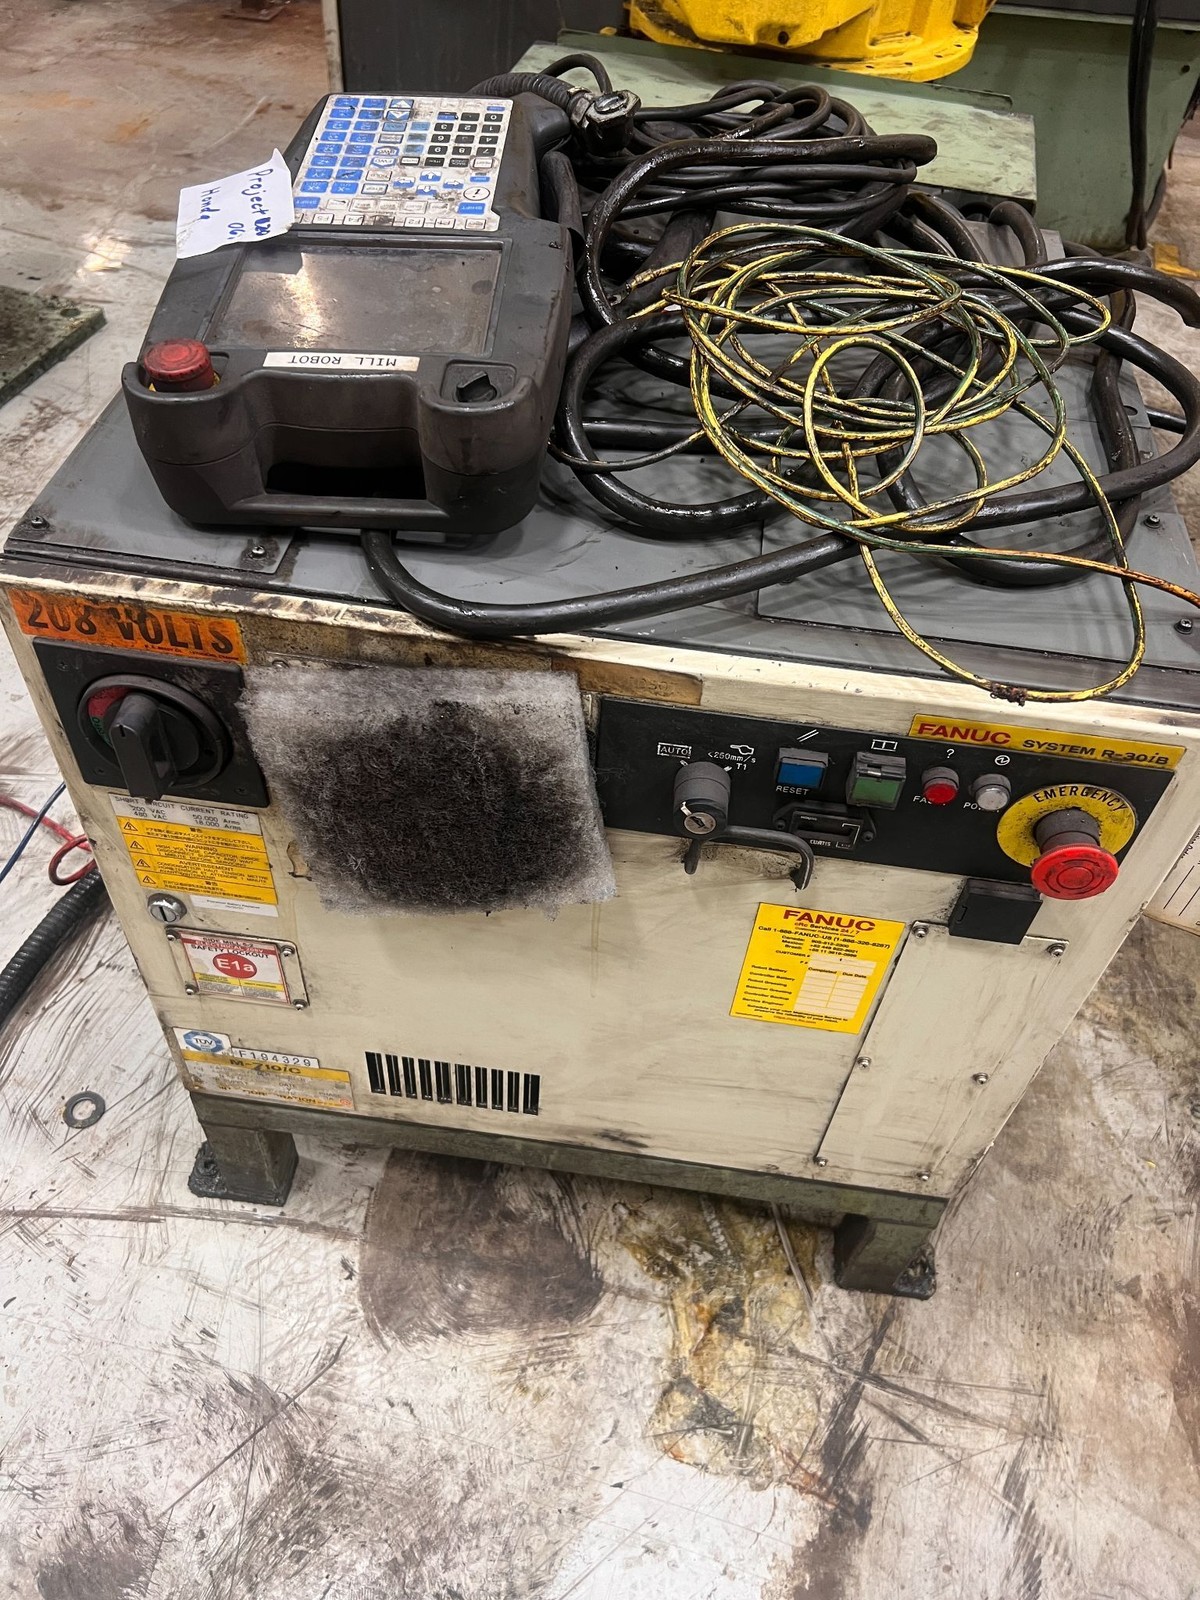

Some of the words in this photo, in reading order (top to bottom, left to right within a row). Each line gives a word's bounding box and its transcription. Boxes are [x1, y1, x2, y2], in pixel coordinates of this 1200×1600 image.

[242, 168, 274, 219] Project
[288, 355, 341, 365] ROBOT
[357, 356, 396, 366] MILL
[28, 598, 98, 635] 208
[109, 606, 234, 654] VOLTS
[660, 746, 689, 756] AUTO
[918, 723, 1012, 744] FANUC
[1023, 739, 1096, 756] SYSTEM
[1101, 749, 1170, 765] R-30iB
[736, 762, 747, 771] T1
[776, 785, 810, 796] RESET
[1033, 786, 1128, 812] EMERGENCY
[115, 796, 139, 804] SHORT
[180, 805, 215, 815] CURRENT
[220, 810, 249, 820] RATING
[185, 844, 218, 852] WARNING
[810, 839, 831, 847] CURTIS
[784, 910, 876, 932] FANUC
[810, 923, 839, 932] Services
[191, 944, 224, 952] SAFETY
[227, 949, 269, 959] LOCKOUT
[217, 958, 255, 973] E1a
[808, 966, 837, 975] Completed
[229, 1058, 301, 1074] M-710iC
[238, 1050, 311, 1067] F194329
